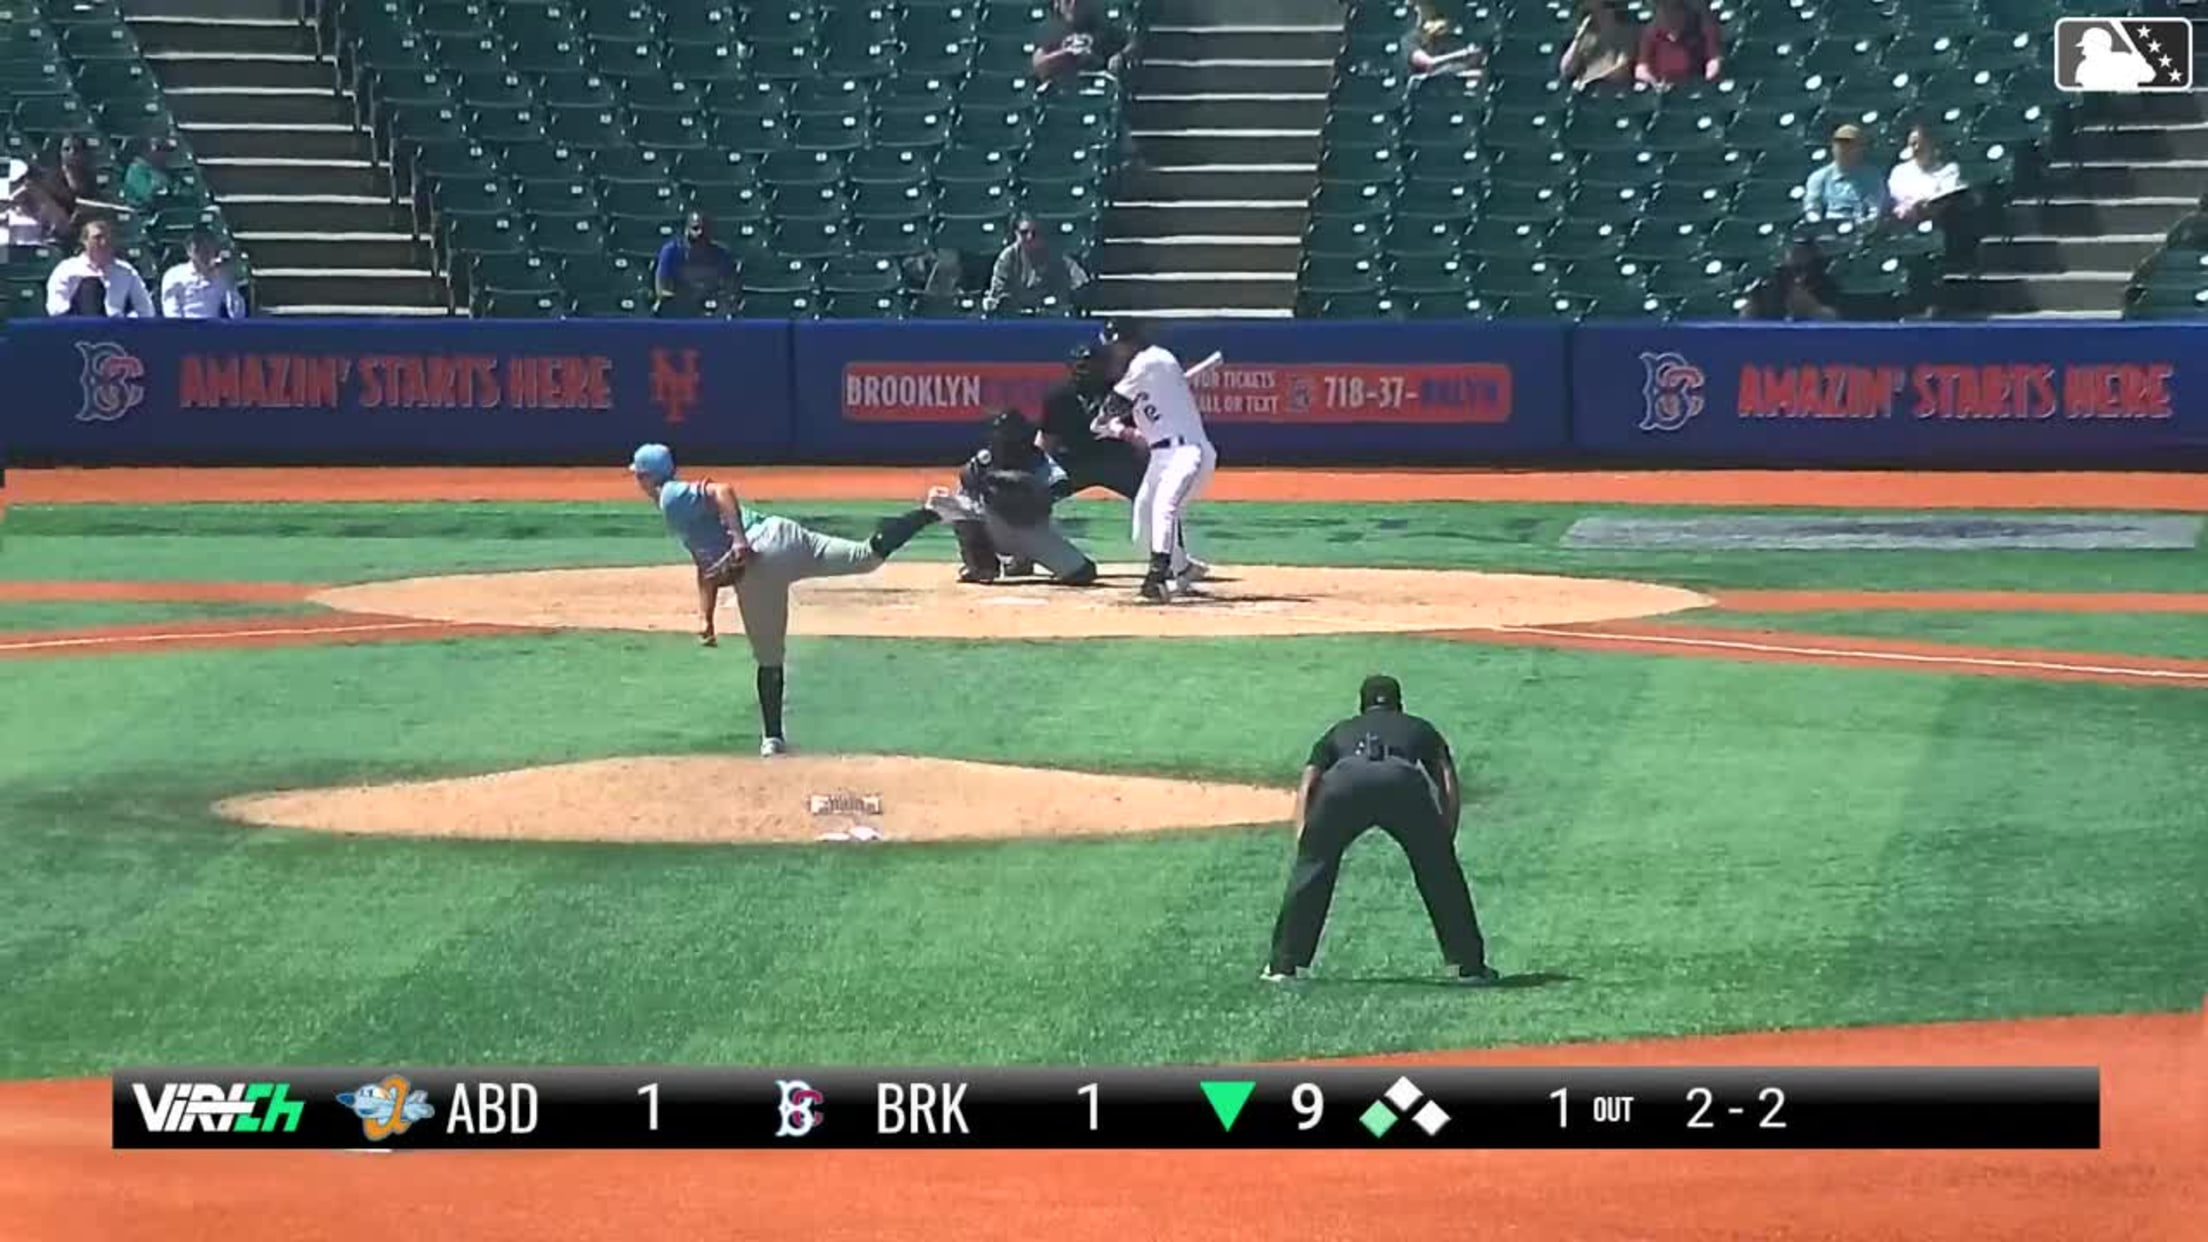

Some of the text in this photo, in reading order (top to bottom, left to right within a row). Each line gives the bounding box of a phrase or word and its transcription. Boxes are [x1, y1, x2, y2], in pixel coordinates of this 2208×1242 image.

[179, 354, 613, 409] AMAZIN' STARTS HERE
[846, 374, 981, 407] BROOKLYN
[1223, 370, 1276, 389] TICKETS
[1738, 363, 2173, 418] AMAZIN' STARTS HERE
[1223, 395, 1243, 412] OR
[1245, 395, 1278, 414] TEXT
